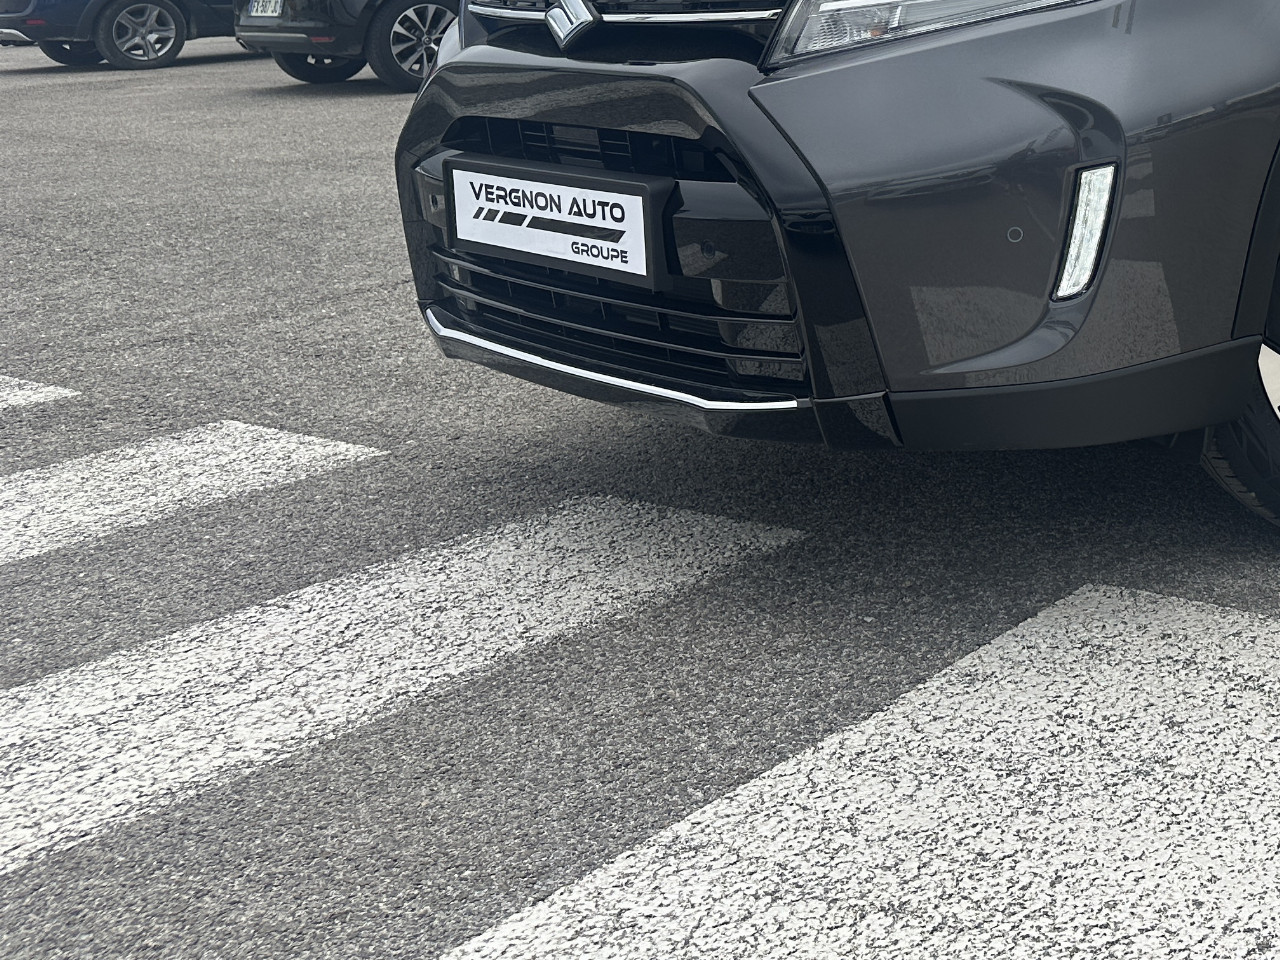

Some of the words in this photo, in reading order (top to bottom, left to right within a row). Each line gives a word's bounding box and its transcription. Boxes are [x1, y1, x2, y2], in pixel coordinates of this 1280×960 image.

[469, 181, 561, 214] VERGNON
[568, 196, 626, 223] AUTO
[571, 241, 629, 265] GROUPE
